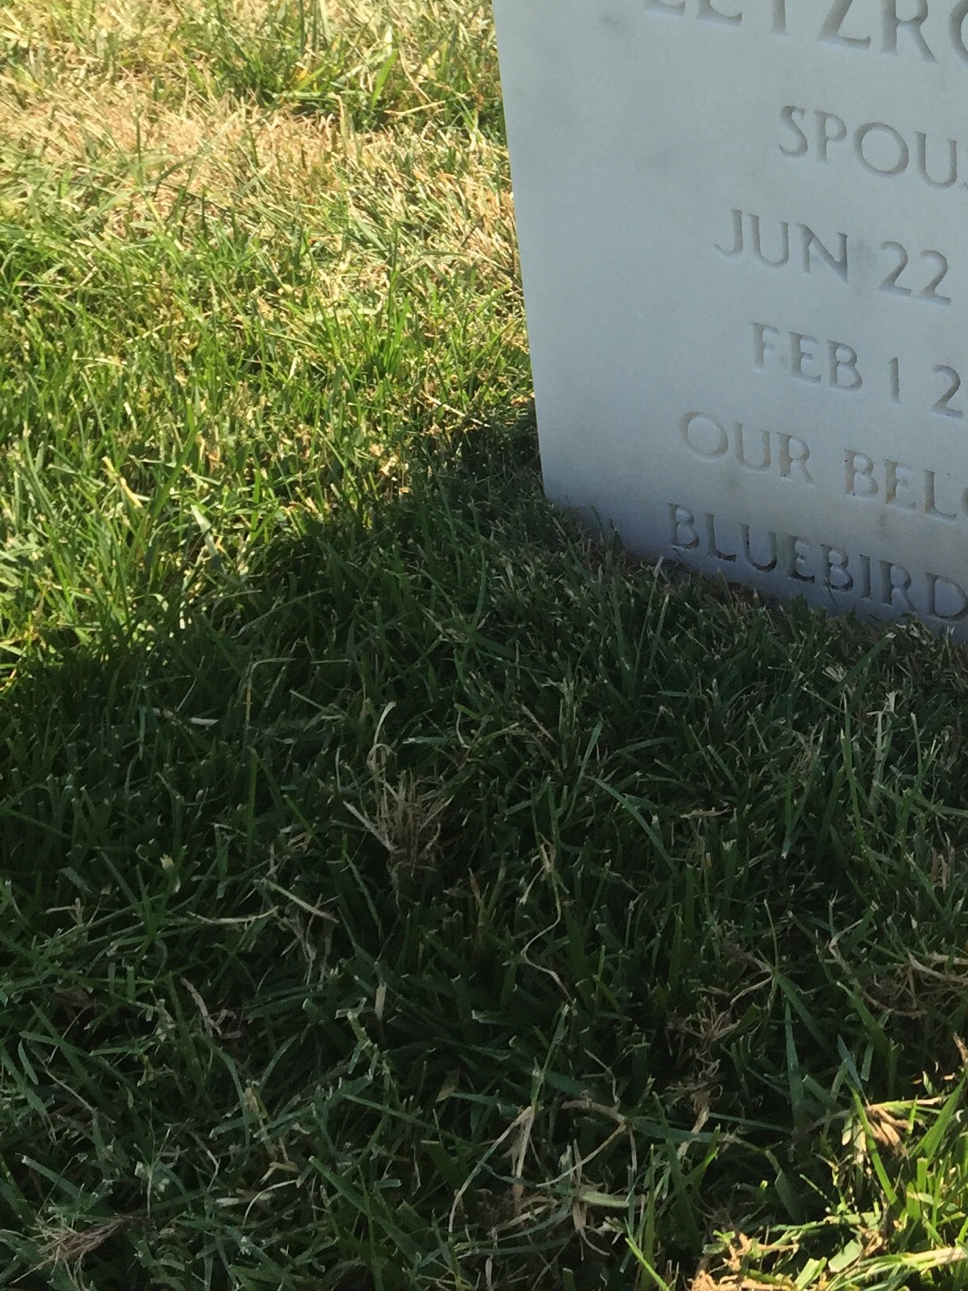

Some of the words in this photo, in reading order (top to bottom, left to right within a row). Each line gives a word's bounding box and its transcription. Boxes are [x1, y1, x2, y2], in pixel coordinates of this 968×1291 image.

[713, 208, 849, 286] JUN
[878, 240, 952, 306] 22
[750, 321, 864, 392] FEB
[886, 356, 901, 404] 1
[679, 410, 814, 487] OUR
